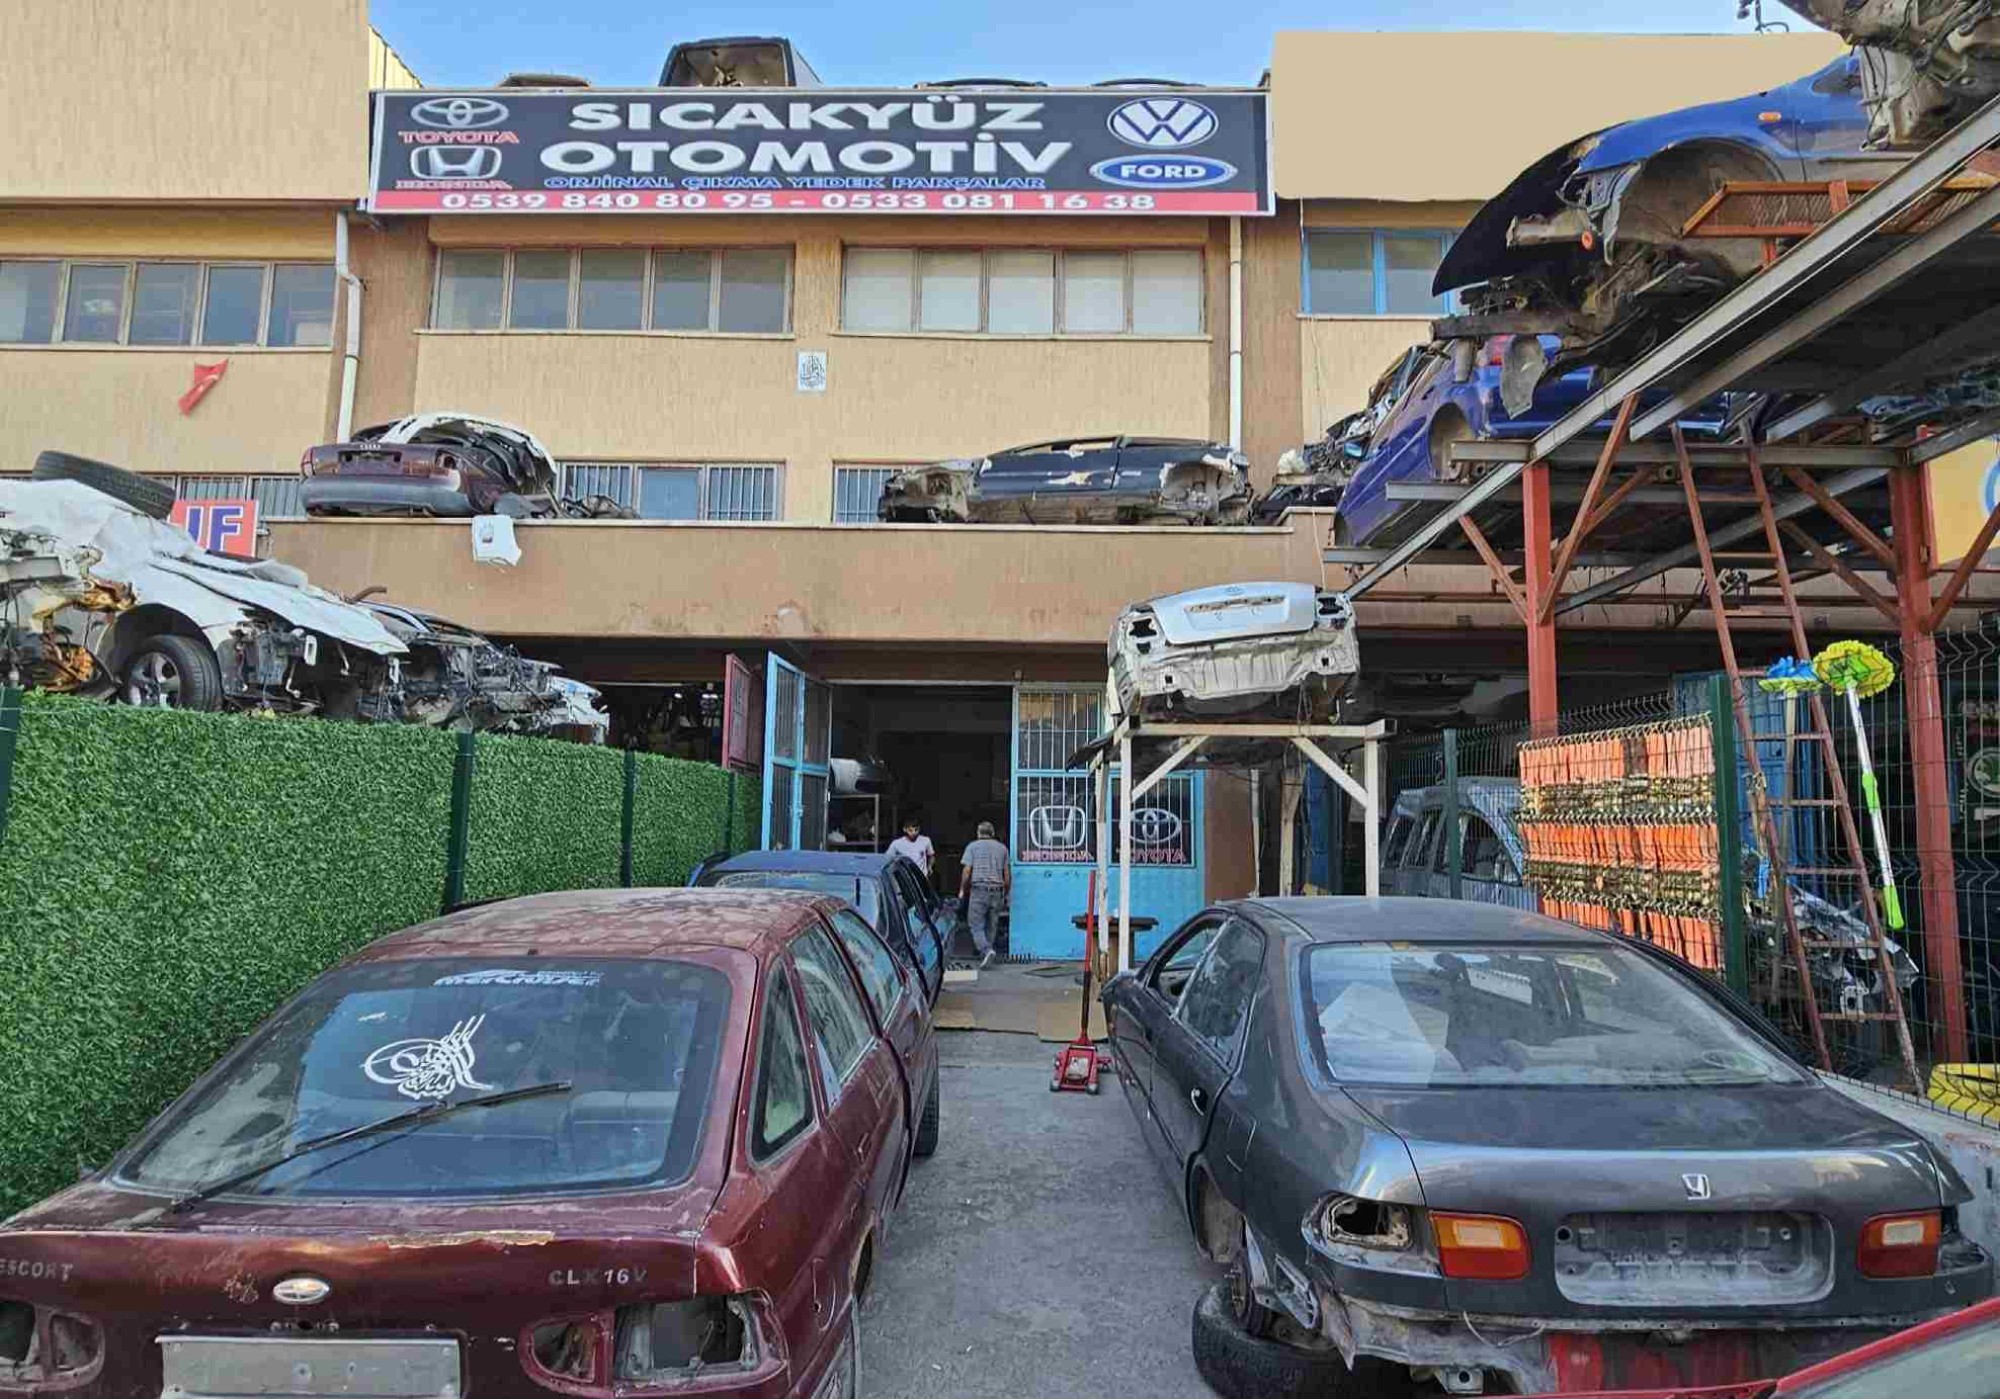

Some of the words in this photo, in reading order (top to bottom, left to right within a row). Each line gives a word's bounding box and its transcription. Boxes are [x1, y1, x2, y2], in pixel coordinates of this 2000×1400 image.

[568, 96, 1045, 131] SICAKYÜZ
[398, 131, 519, 144] TOYOTA
[539, 132, 1072, 174] OTOMOTİV
[1120, 164, 1206, 178] FORD
[788, 177, 886, 189] YEDEK
[892, 177, 1046, 191] PARÇALAR
[442, 193, 547, 209] 0539
[562, 193, 639, 208] 840
[655, 193, 706, 208] 80
[722, 193, 773, 208] 95
[821, 193, 927, 209] 0533
[942, 193, 1014, 209] 081
[1040, 193, 1088, 209] 16
[1103, 194, 1155, 209] 38
[0, 1258, 74, 1282] ESCORT
